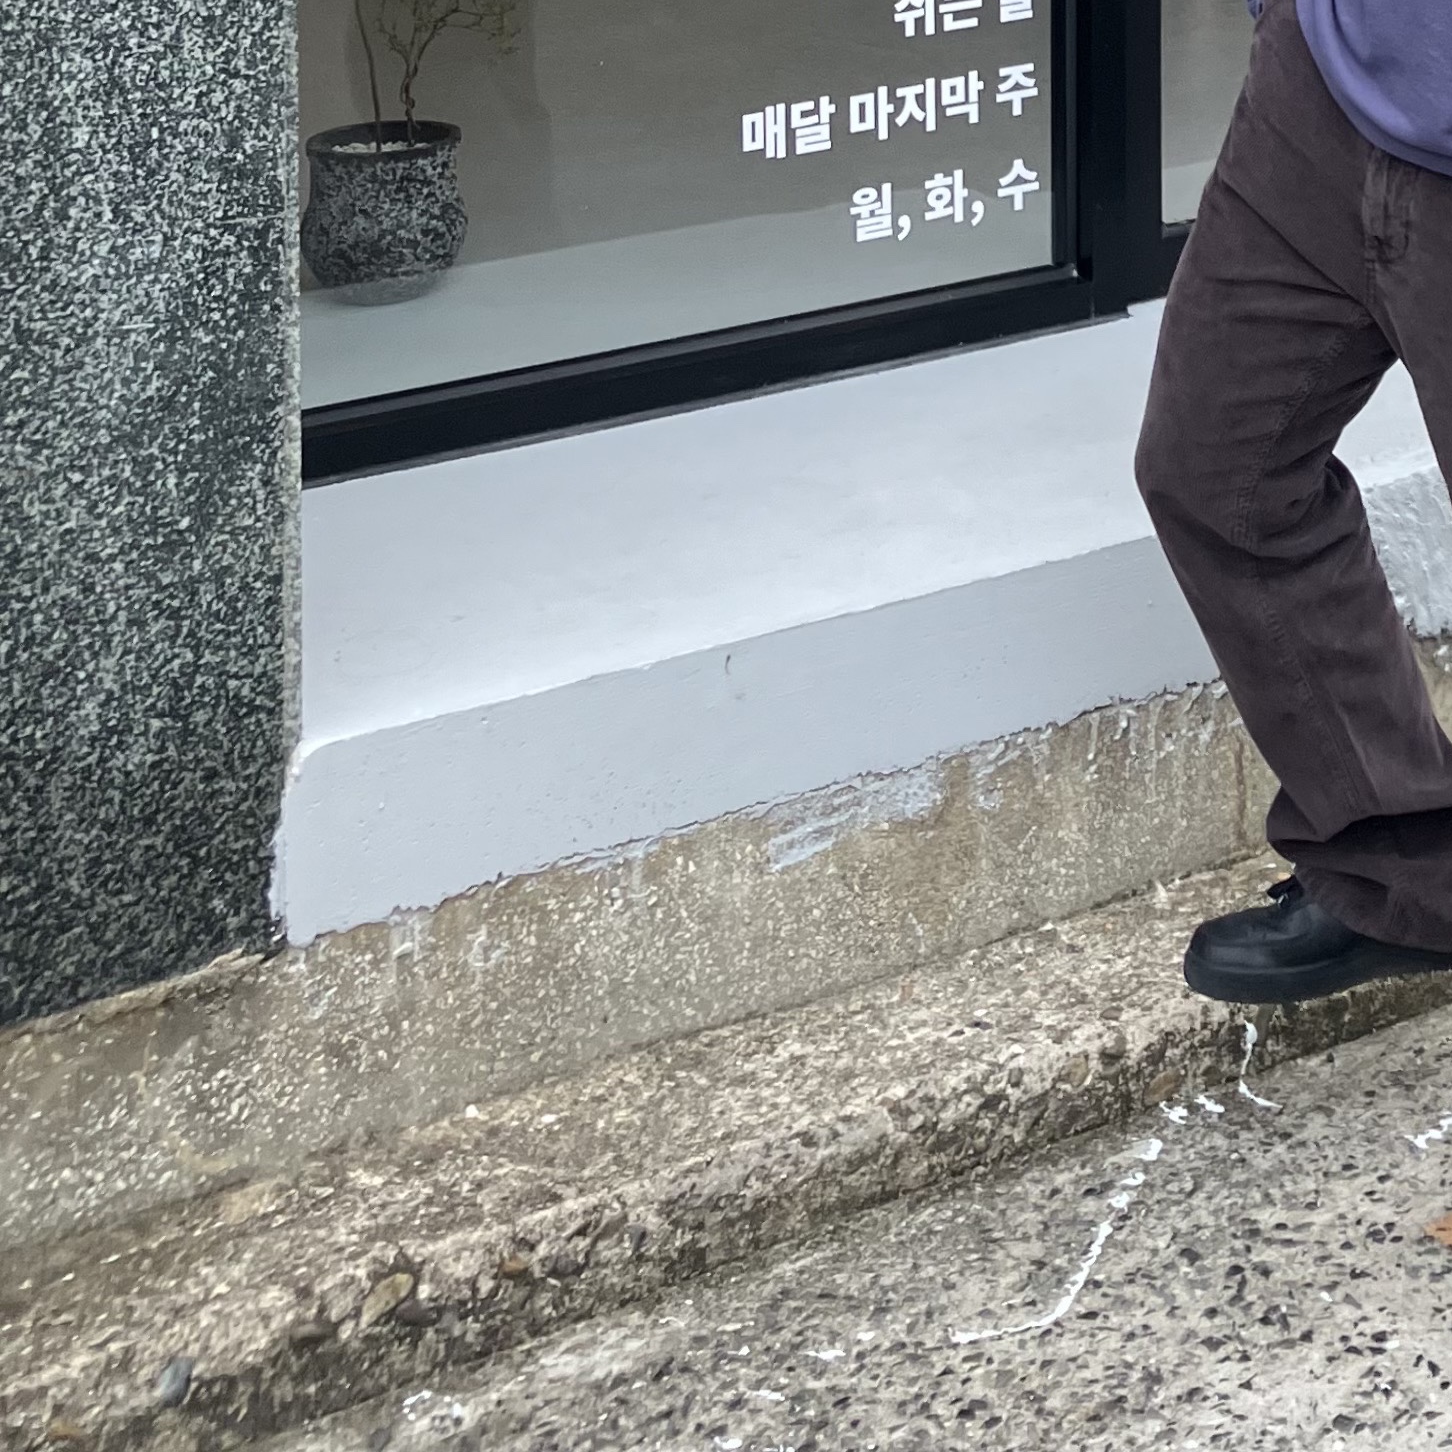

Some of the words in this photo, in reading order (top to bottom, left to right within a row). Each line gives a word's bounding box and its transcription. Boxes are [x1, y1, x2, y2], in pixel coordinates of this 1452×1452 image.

[742, 95, 836, 159] 매달
[849, 69, 985, 141] 마지막
[995, 62, 1039, 117] 주
[849, 182, 912, 243] 월,
[924, 168, 985, 227] 화,
[997, 158, 1040, 211] 수
